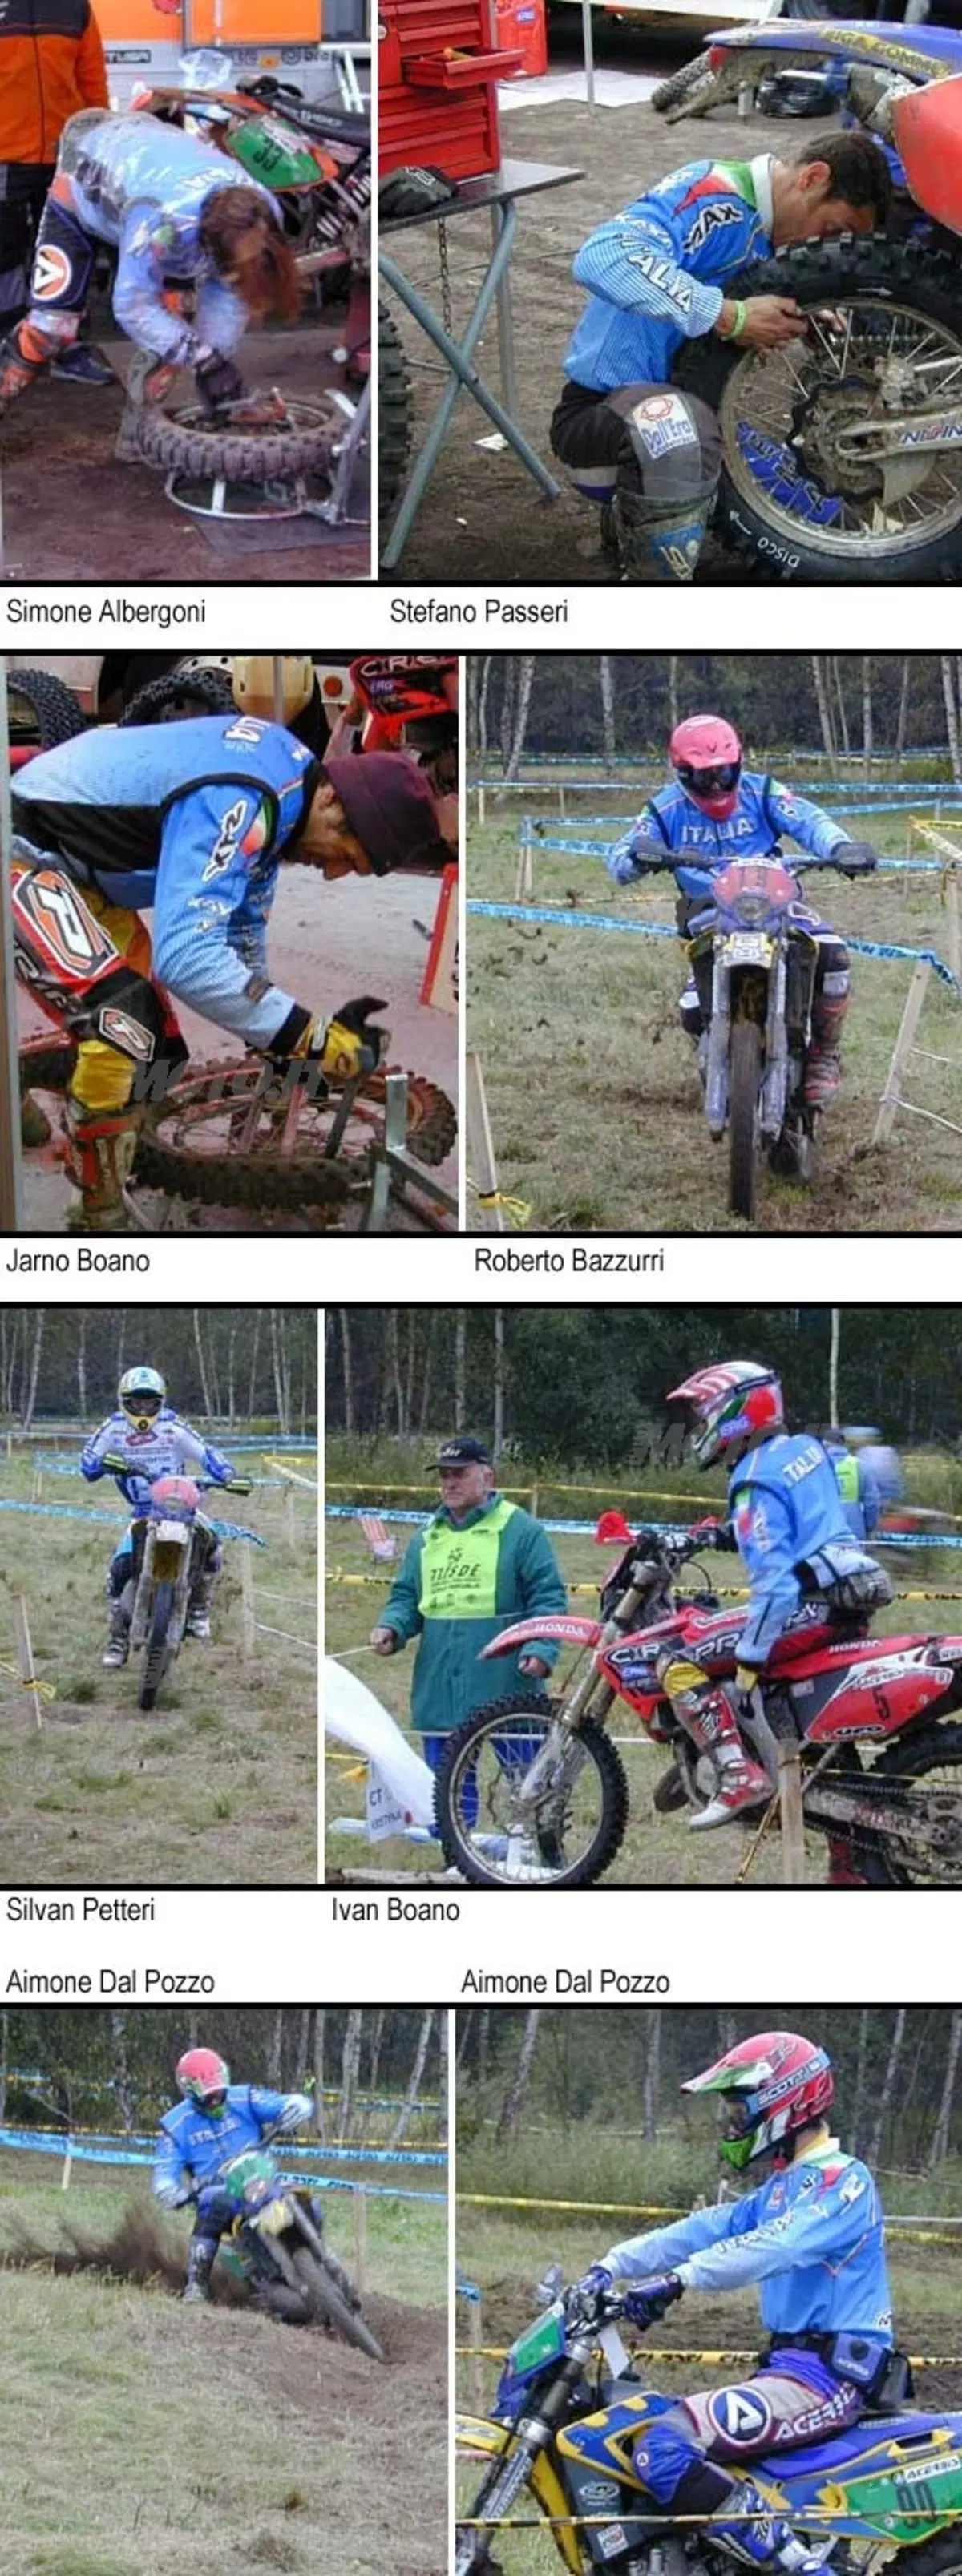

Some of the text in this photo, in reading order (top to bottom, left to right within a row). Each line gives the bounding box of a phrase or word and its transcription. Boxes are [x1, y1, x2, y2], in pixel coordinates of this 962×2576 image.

[756, 537, 801, 570] DISCO
[682, 817, 754, 843] ITALIA
[533, 1622, 586, 1635] HONDA
[828, 1639, 879, 1653] HONDA
